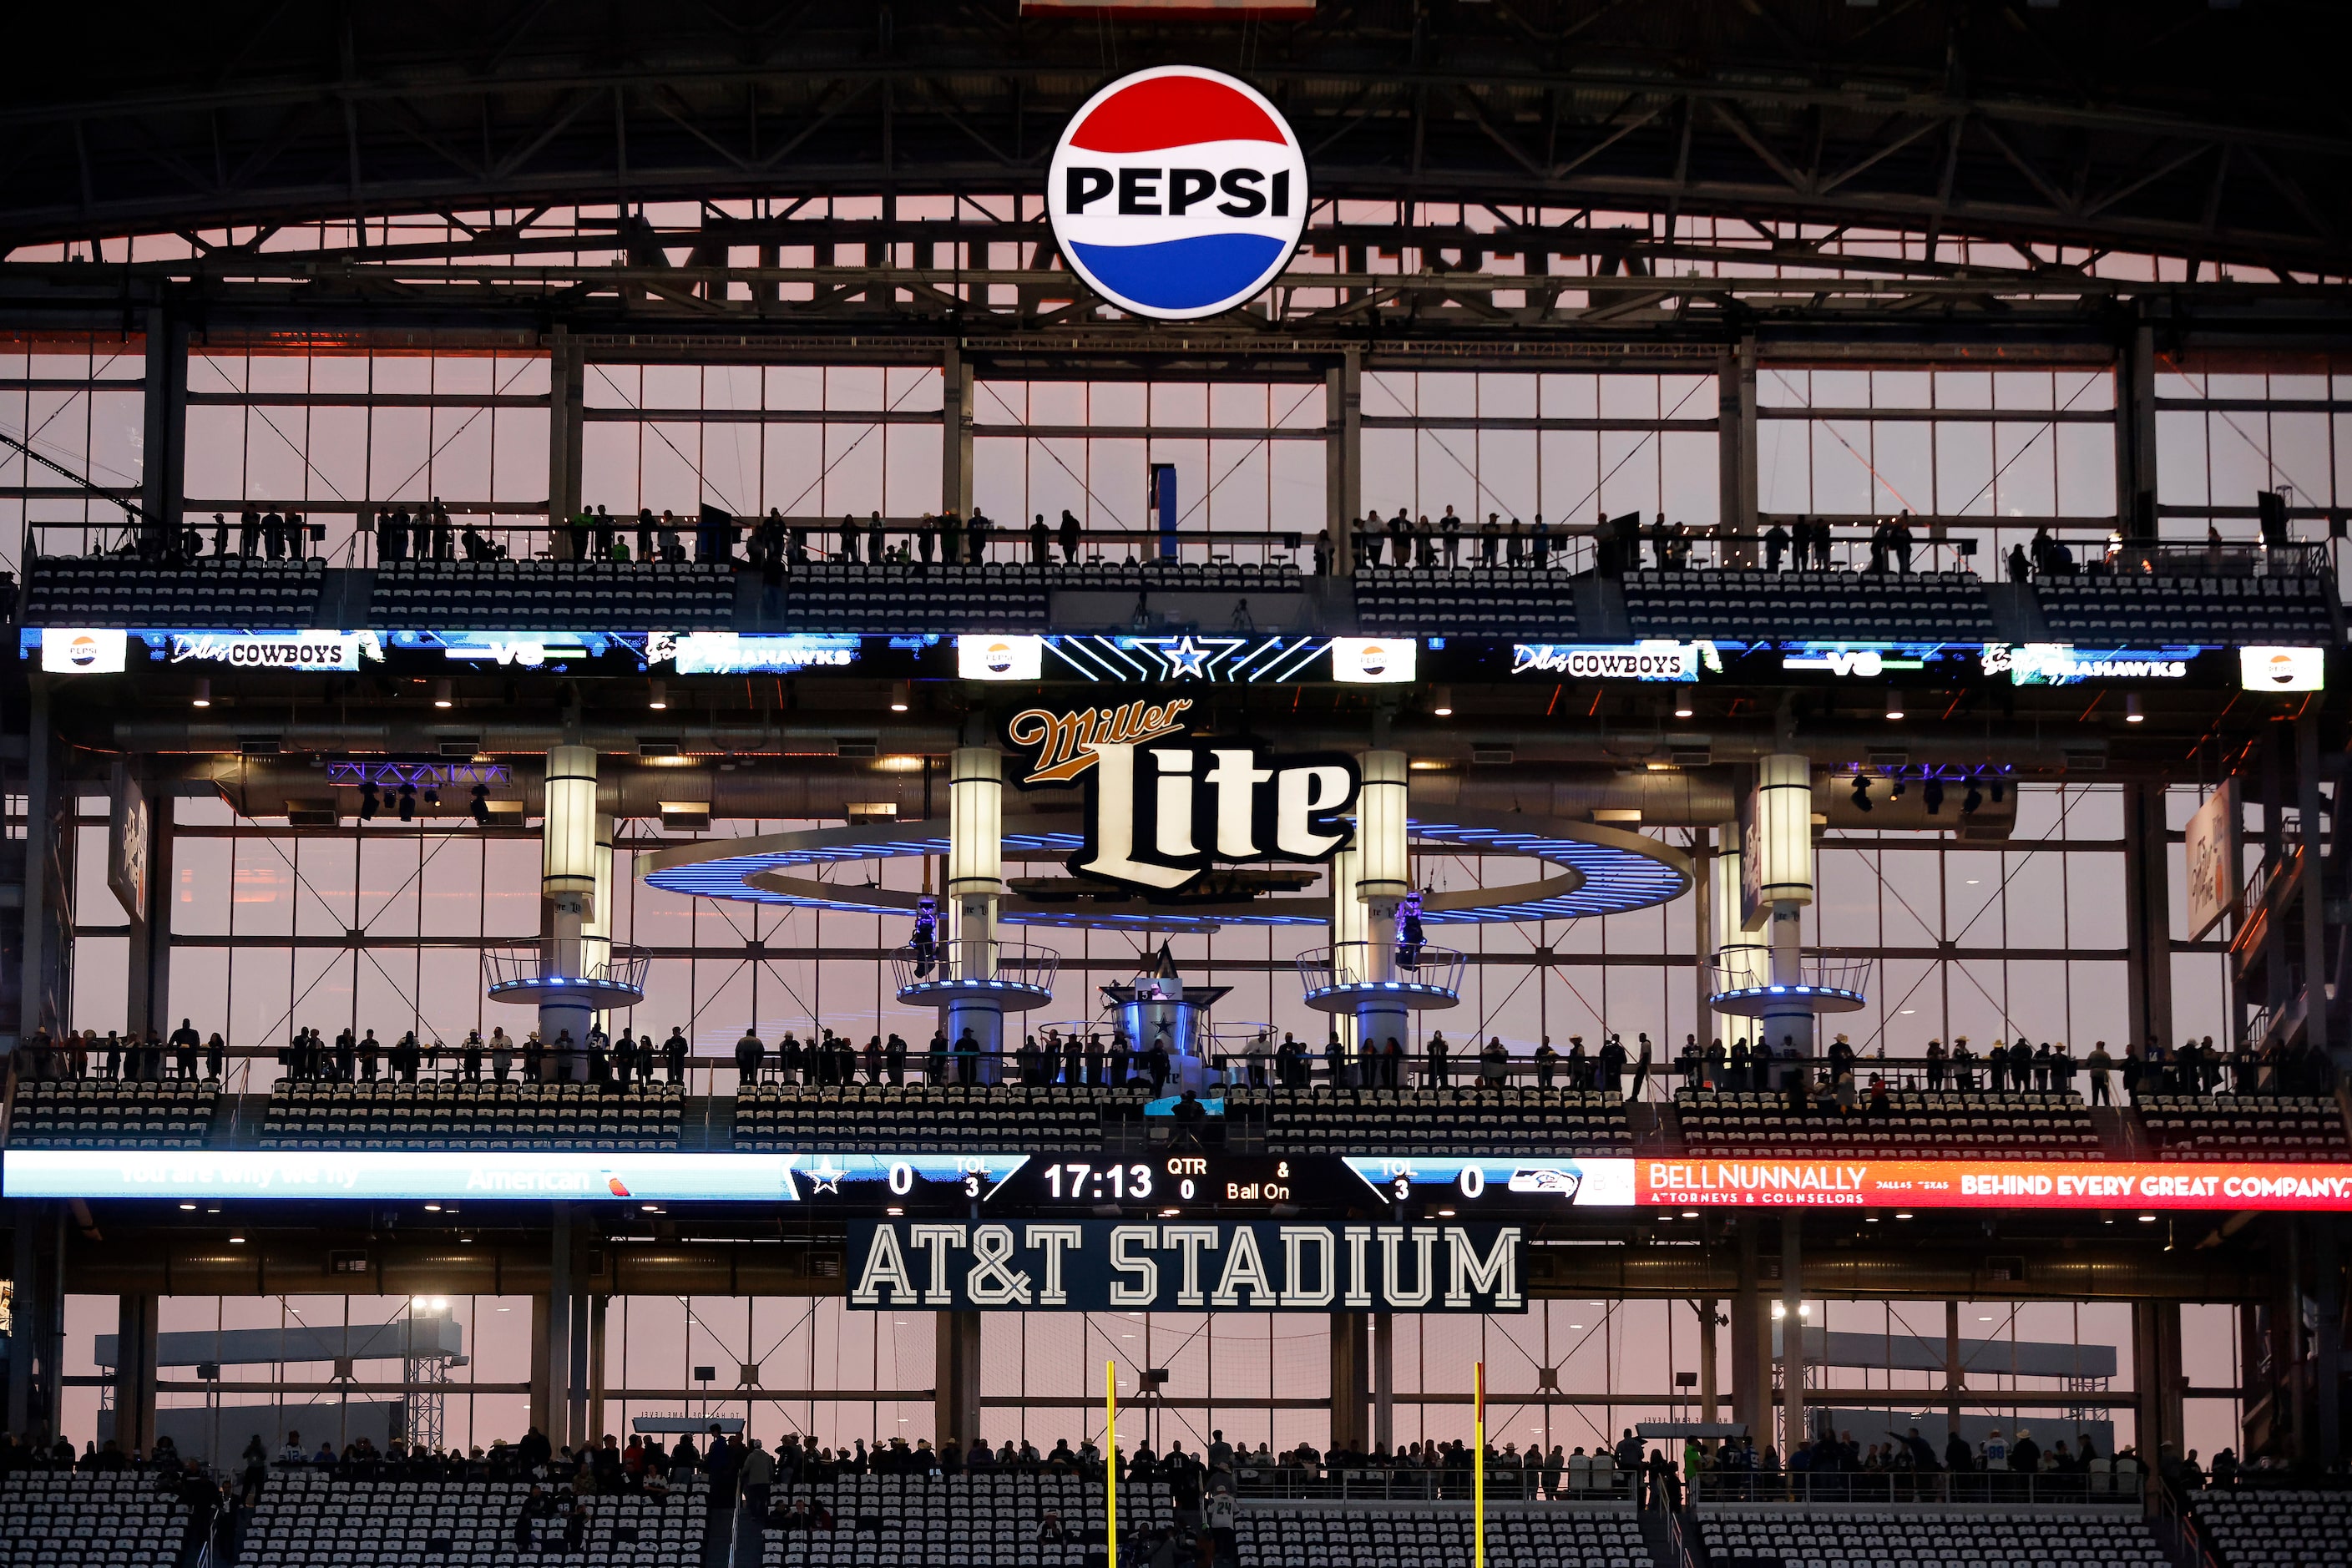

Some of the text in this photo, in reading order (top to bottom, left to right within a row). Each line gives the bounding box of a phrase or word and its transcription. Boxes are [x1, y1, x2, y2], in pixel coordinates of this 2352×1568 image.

[1066, 166, 1290, 218] PEPSI
[231, 643, 343, 665] COWBOYS
[706, 650, 851, 665] AHAWKS
[1571, 655, 1682, 675] COWBOYS
[2041, 662, 2186, 677] AHAWKS
[1009, 698, 1192, 783] Miller
[1080, 743, 1351, 889] Lite
[953, 1157, 992, 1174] TOL
[1167, 1159, 1206, 1175] QTR
[1379, 1160, 1419, 1176] TOL
[467, 1166, 589, 1190] American
[888, 1161, 913, 1195] 0
[965, 1178, 979, 1197] 3
[1044, 1164, 1152, 1198] 17:13
[1460, 1165, 1485, 1199] 0
[1961, 1175, 2051, 1196] BEHIND
[2056, 1176, 2132, 1196] EVERY
[2140, 1176, 2219, 1197] GREAT
[1181, 1179, 1195, 1199] 0
[1227, 1183, 1290, 1200] Ball On
[1395, 1179, 1409, 1200] 3
[1746, 1193, 1754, 1203] &
[1763, 1193, 1864, 1205] COUNSELORS
[852, 1223, 1523, 1308] AT&T STADIUM
[1216, 1501, 1232, 1515] 24
